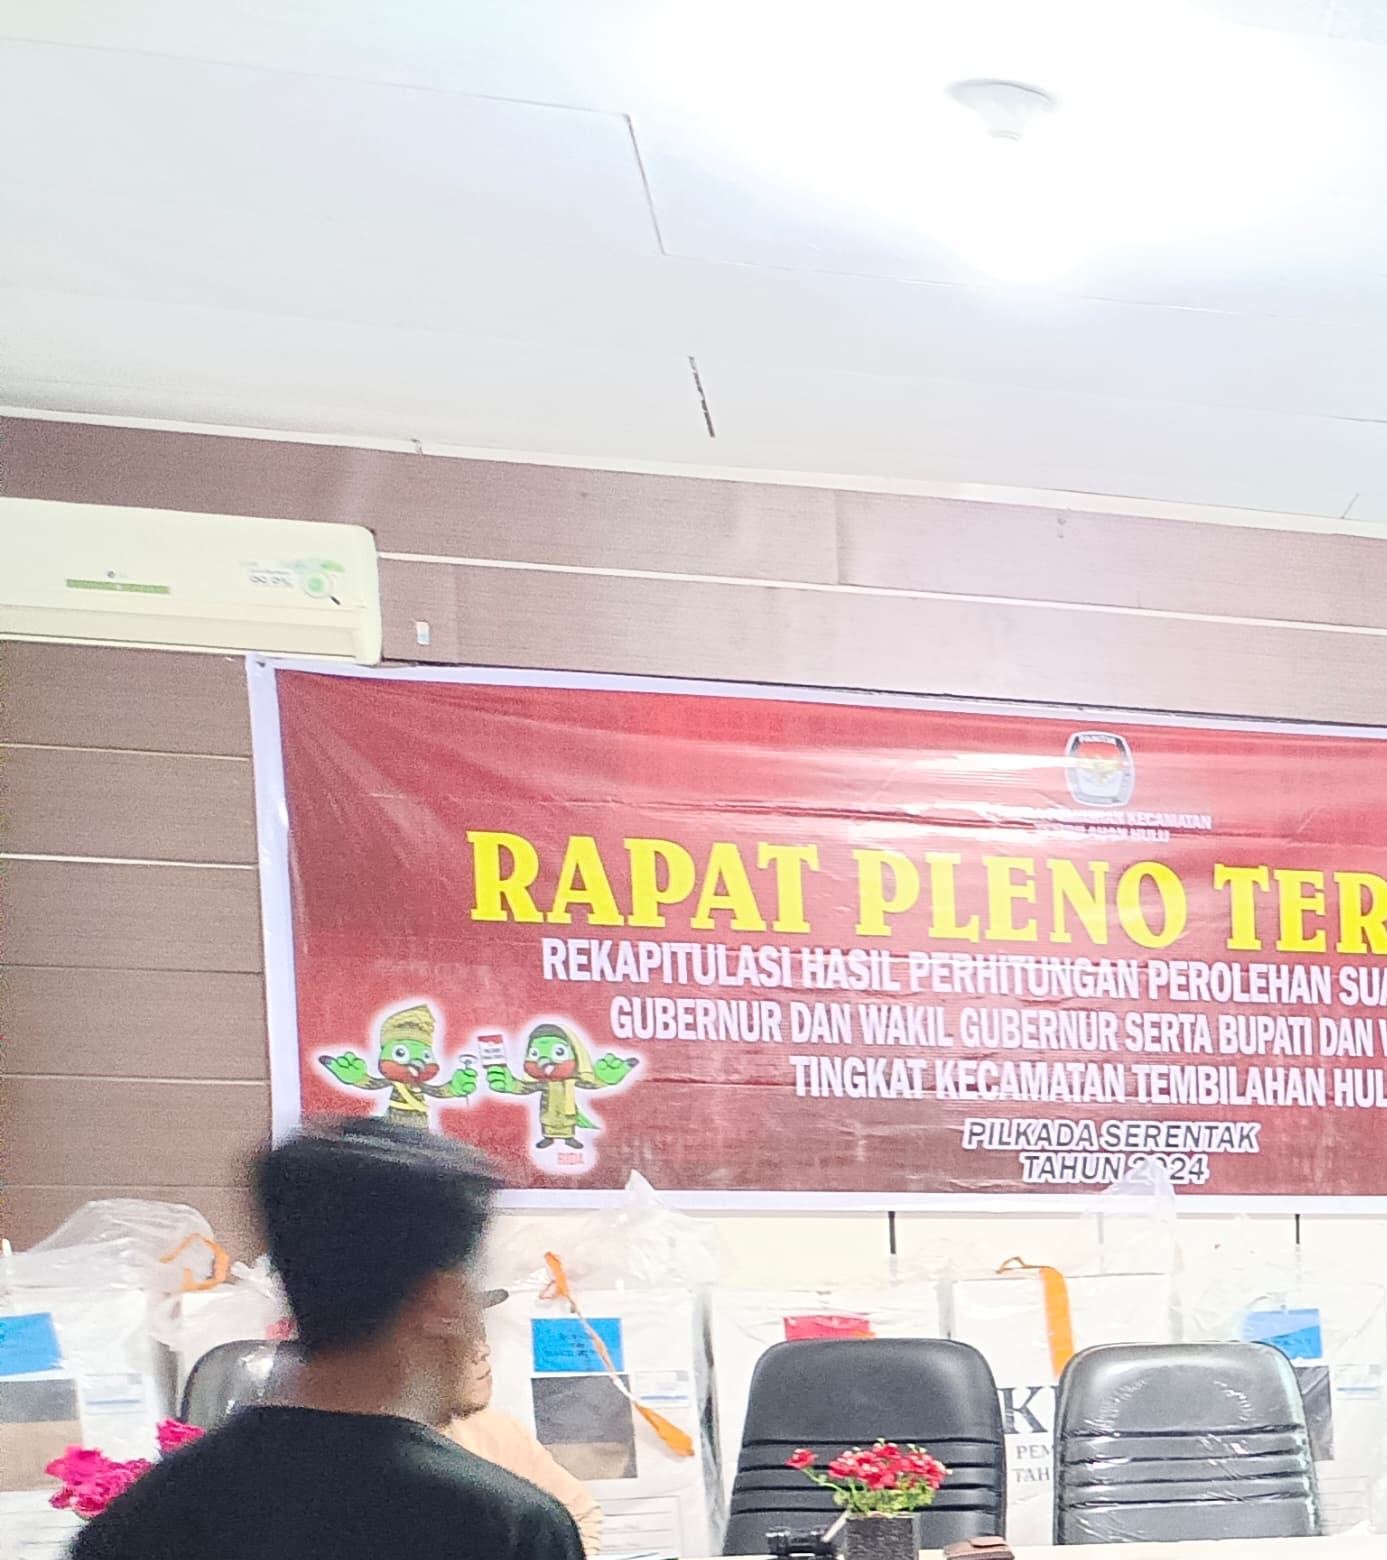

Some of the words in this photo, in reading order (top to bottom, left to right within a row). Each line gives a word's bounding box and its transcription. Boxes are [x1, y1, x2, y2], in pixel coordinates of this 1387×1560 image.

[466, 830, 820, 934] RAPAT
[853, 849, 1188, 949] PLENO
[541, 937, 793, 988] REKAPITULASI
[801, 947, 902, 992] HASIL
[908, 951, 1140, 1000] PERHITUNGAN
[1147, 959, 1332, 1005] PEROLEHAN
[610, 995, 783, 1043] GUBERNUR
[790, 1001, 852, 1045] DAN
[858, 1002, 954, 1048] WAKIL
[960, 1006, 1119, 1051] GUBERNUR
[1125, 1011, 1214, 1055] SERTA
[1218, 1014, 1313, 1057] BUPATI
[1319, 1017, 1374, 1058] DAN
[789, 1055, 928, 1100] TINGKAT
[935, 1058, 1125, 1103] KECAMATAN
[1130, 1063, 1329, 1107] TEMBILAHAN
[964, 1119, 1097, 1149] PILKADA
[1102, 1121, 1259, 1151] SERENTAK
[1022, 1154, 1124, 1182] TAHUN
